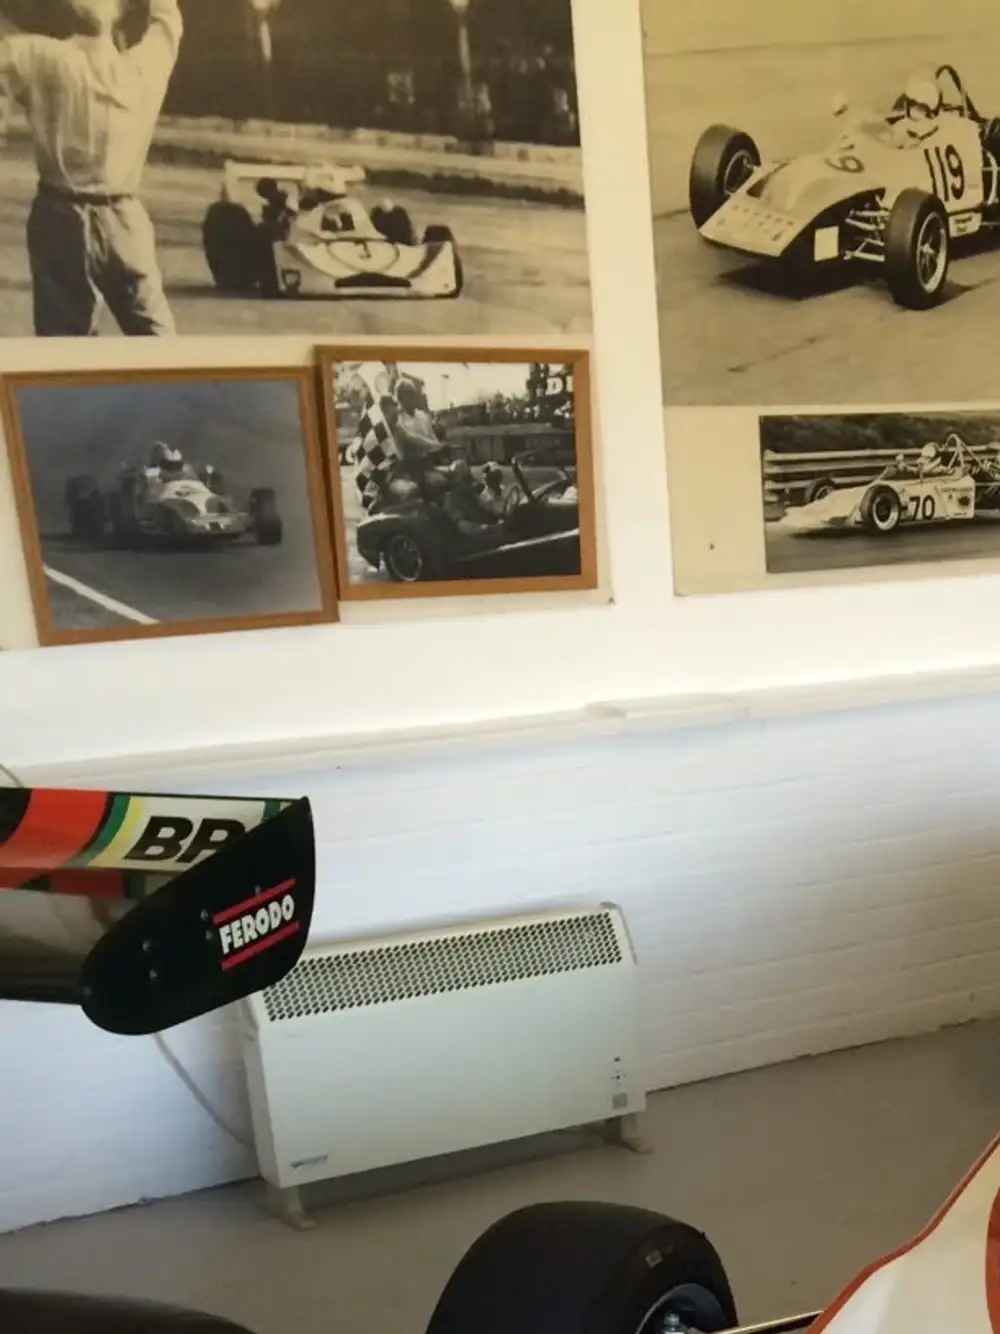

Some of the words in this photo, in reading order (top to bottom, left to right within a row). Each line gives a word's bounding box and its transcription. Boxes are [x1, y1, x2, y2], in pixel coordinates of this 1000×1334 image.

[922, 143, 965, 202] 119
[908, 494, 936, 520] 70
[122, 816, 246, 863] BP
[218, 894, 295, 955] FERODO
